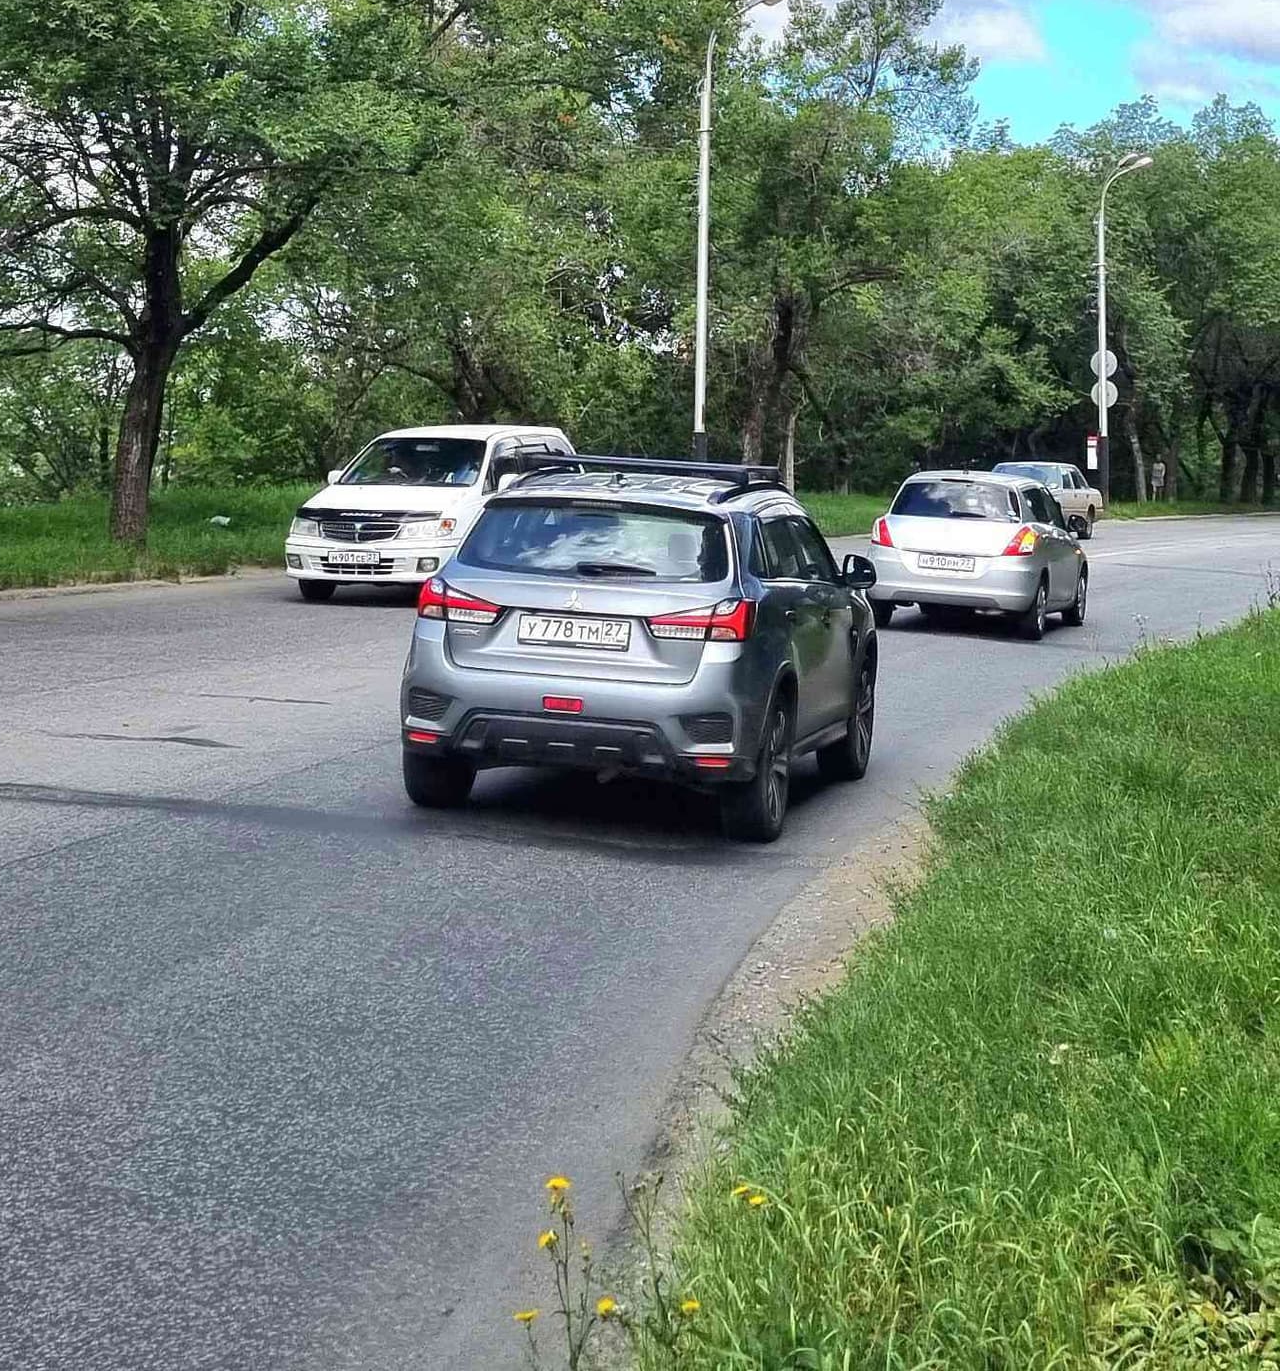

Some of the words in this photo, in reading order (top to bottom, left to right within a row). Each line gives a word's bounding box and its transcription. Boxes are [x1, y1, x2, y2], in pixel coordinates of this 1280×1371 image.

[527, 621, 538, 636] У
[540, 619, 574, 638] 778
[577, 625, 600, 641] ТМ
[604, 622, 624, 637] 27
